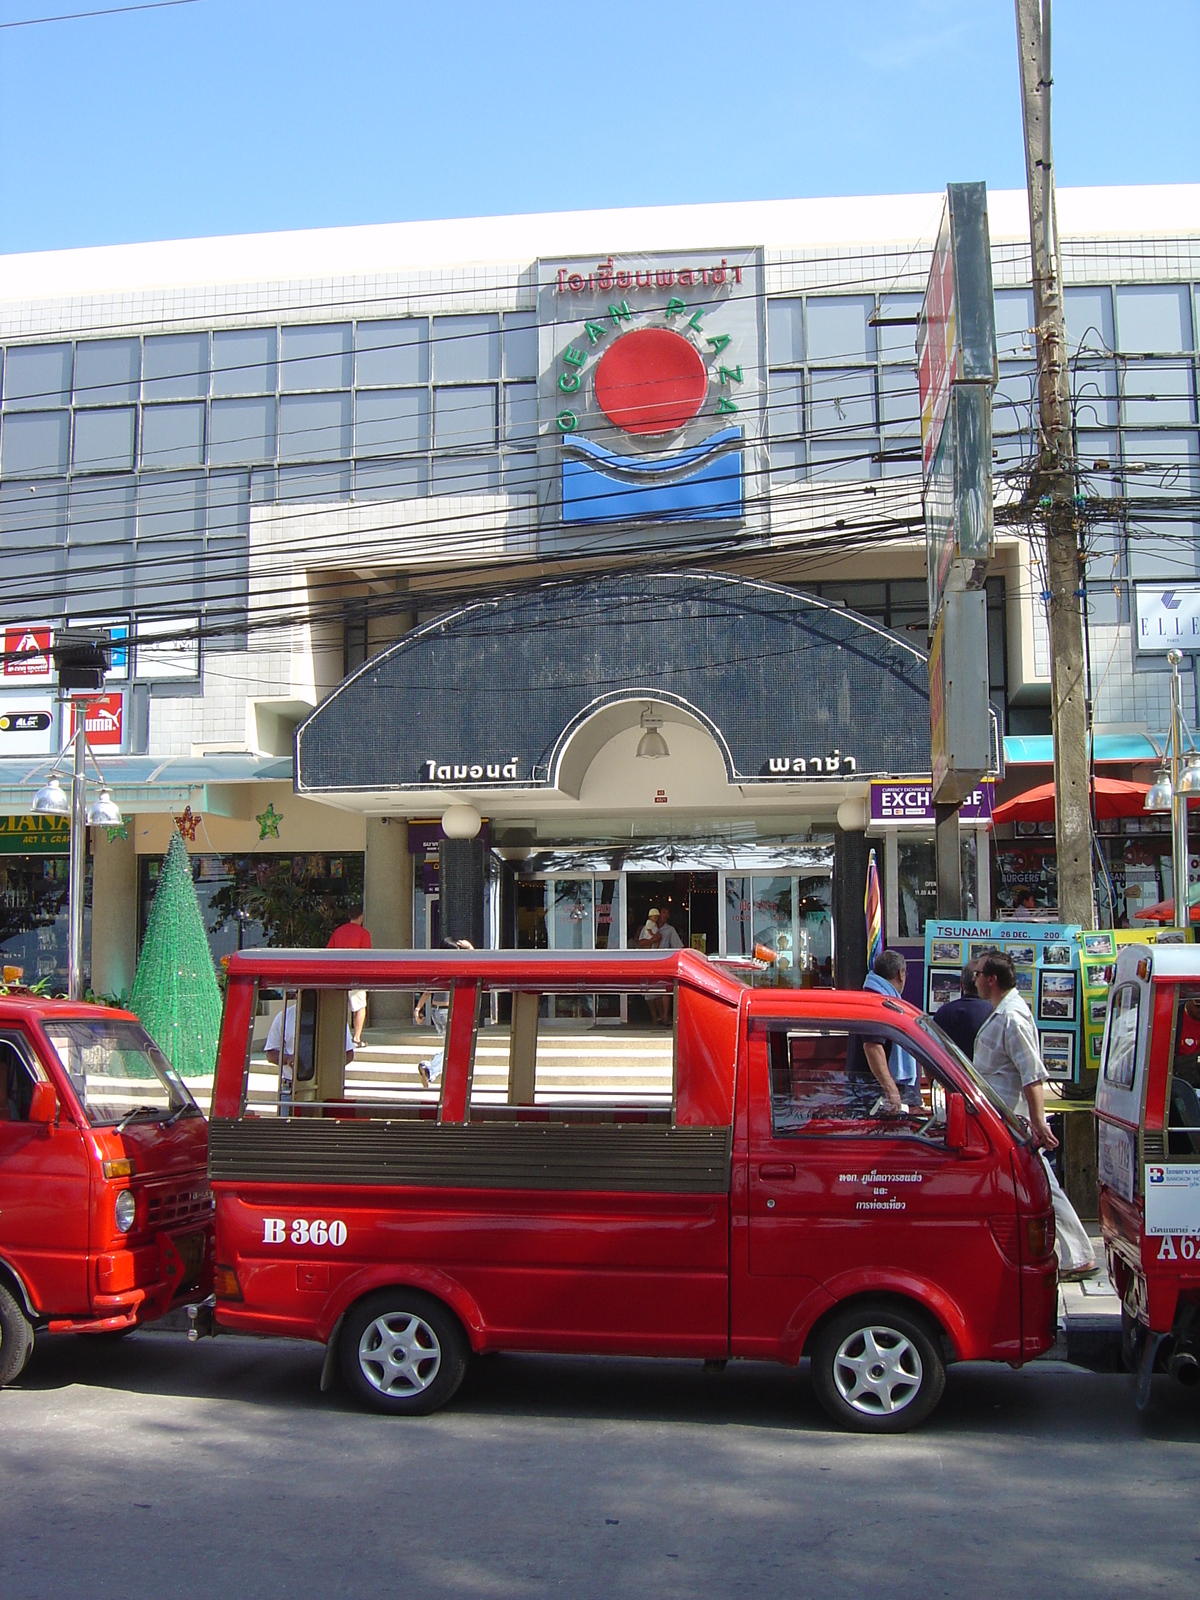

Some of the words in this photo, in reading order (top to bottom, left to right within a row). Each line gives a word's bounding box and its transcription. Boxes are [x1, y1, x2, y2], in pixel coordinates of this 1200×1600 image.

[556, 300, 632, 431] OCEAN
[665, 296, 743, 415] PLAZA
[1141, 616, 1199, 636] ELLE
[85, 718, 116, 732] UMA.
[426, 756, 519, 780] ไดมอนด์
[769, 750, 856, 772] พลาซ่า
[0, 815, 70, 831] IANA
[23, 835, 38, 844] ART
[1002, 873, 1040, 883] BURGERS
[937, 926, 992, 938] TSUNAMI
[1012, 931, 1031, 939] DEC.
